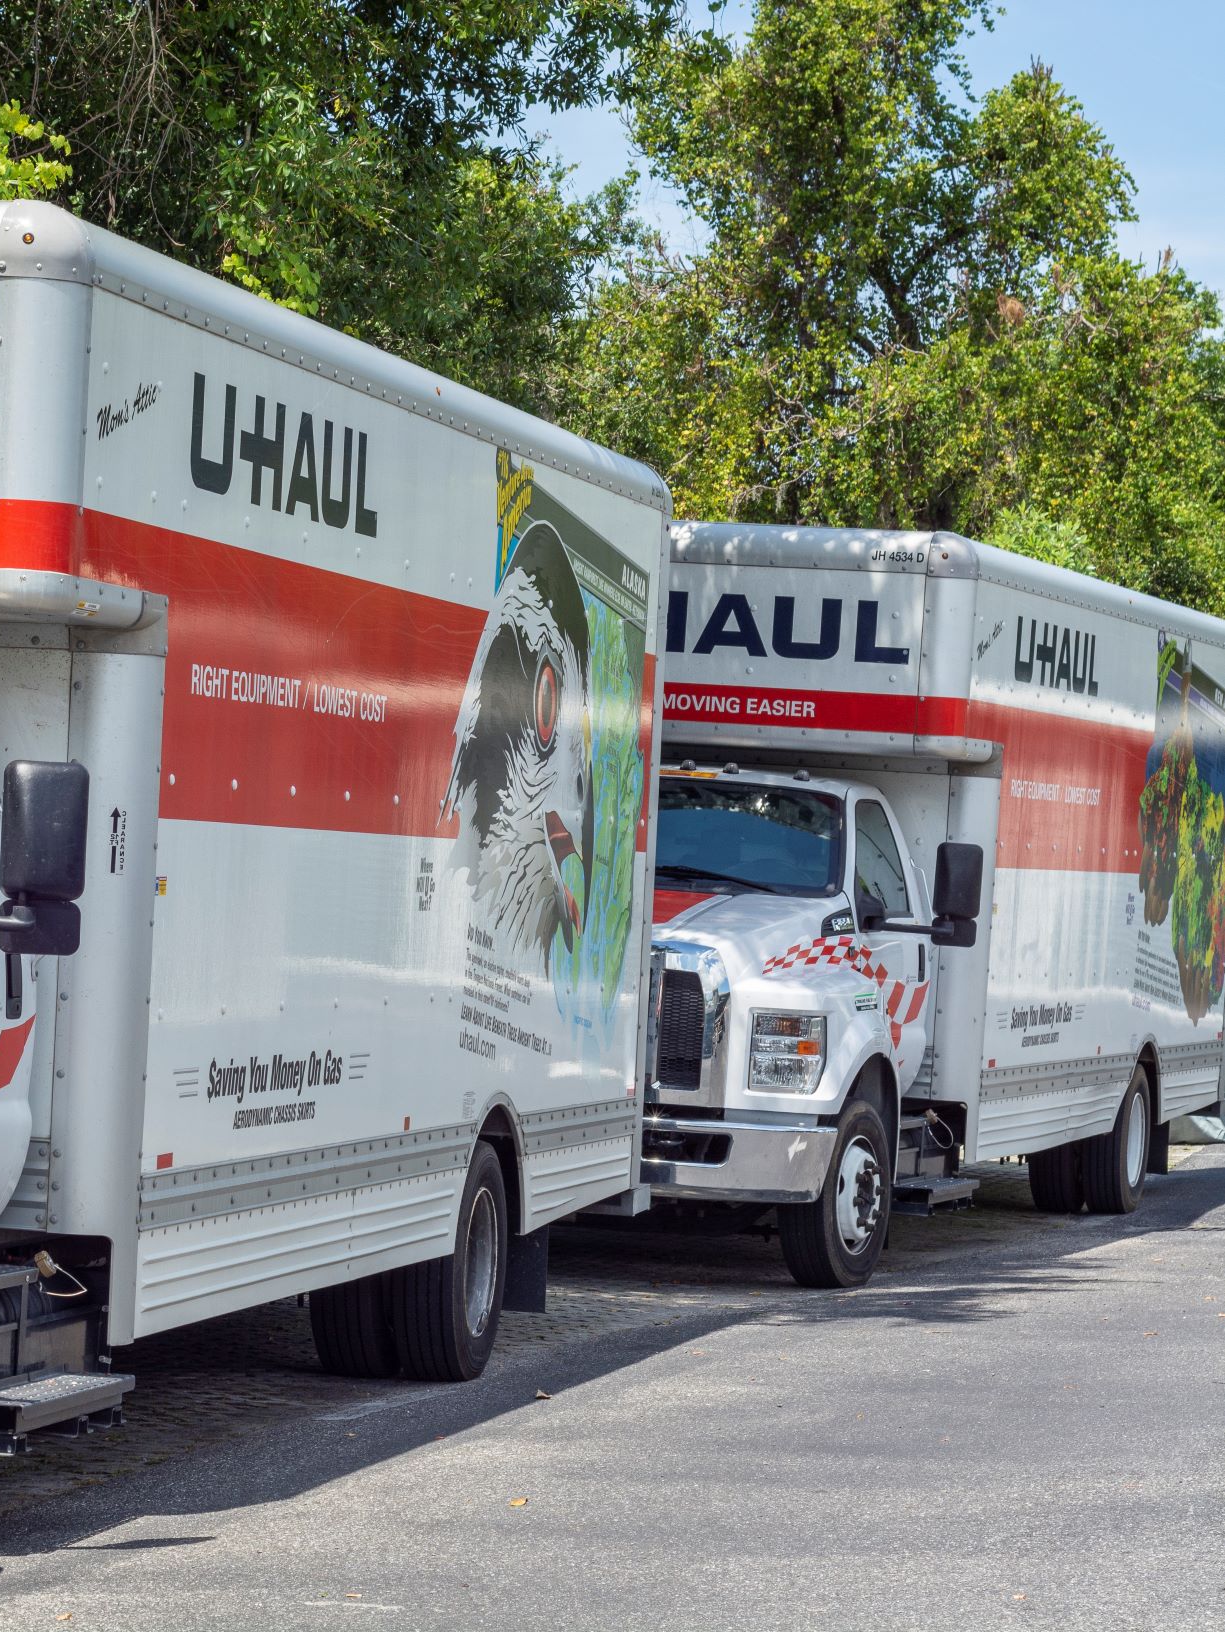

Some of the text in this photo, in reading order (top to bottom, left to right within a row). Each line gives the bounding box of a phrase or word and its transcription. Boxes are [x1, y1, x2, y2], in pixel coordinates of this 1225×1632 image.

[871, 550, 925, 563] JH 4534 D
[621, 563, 646, 601] ALASKA
[191, 663, 230, 699] RIGHT
[231, 670, 301, 709] EQUIPMENT
[313, 683, 358, 719] LOWEST
[360, 692, 387, 723] COST
[662, 692, 816, 718] MOVING EASIER
[459, 1027, 496, 1060] uhaul.com
[249, 1055, 269, 1094] You
[270, 1054, 306, 1097] Money
[307, 1050, 322, 1088] On
[323, 1049, 343, 1086] Gas
[233, 1101, 316, 1130] AERODYNAMIC CHASSIS SKIRTS
